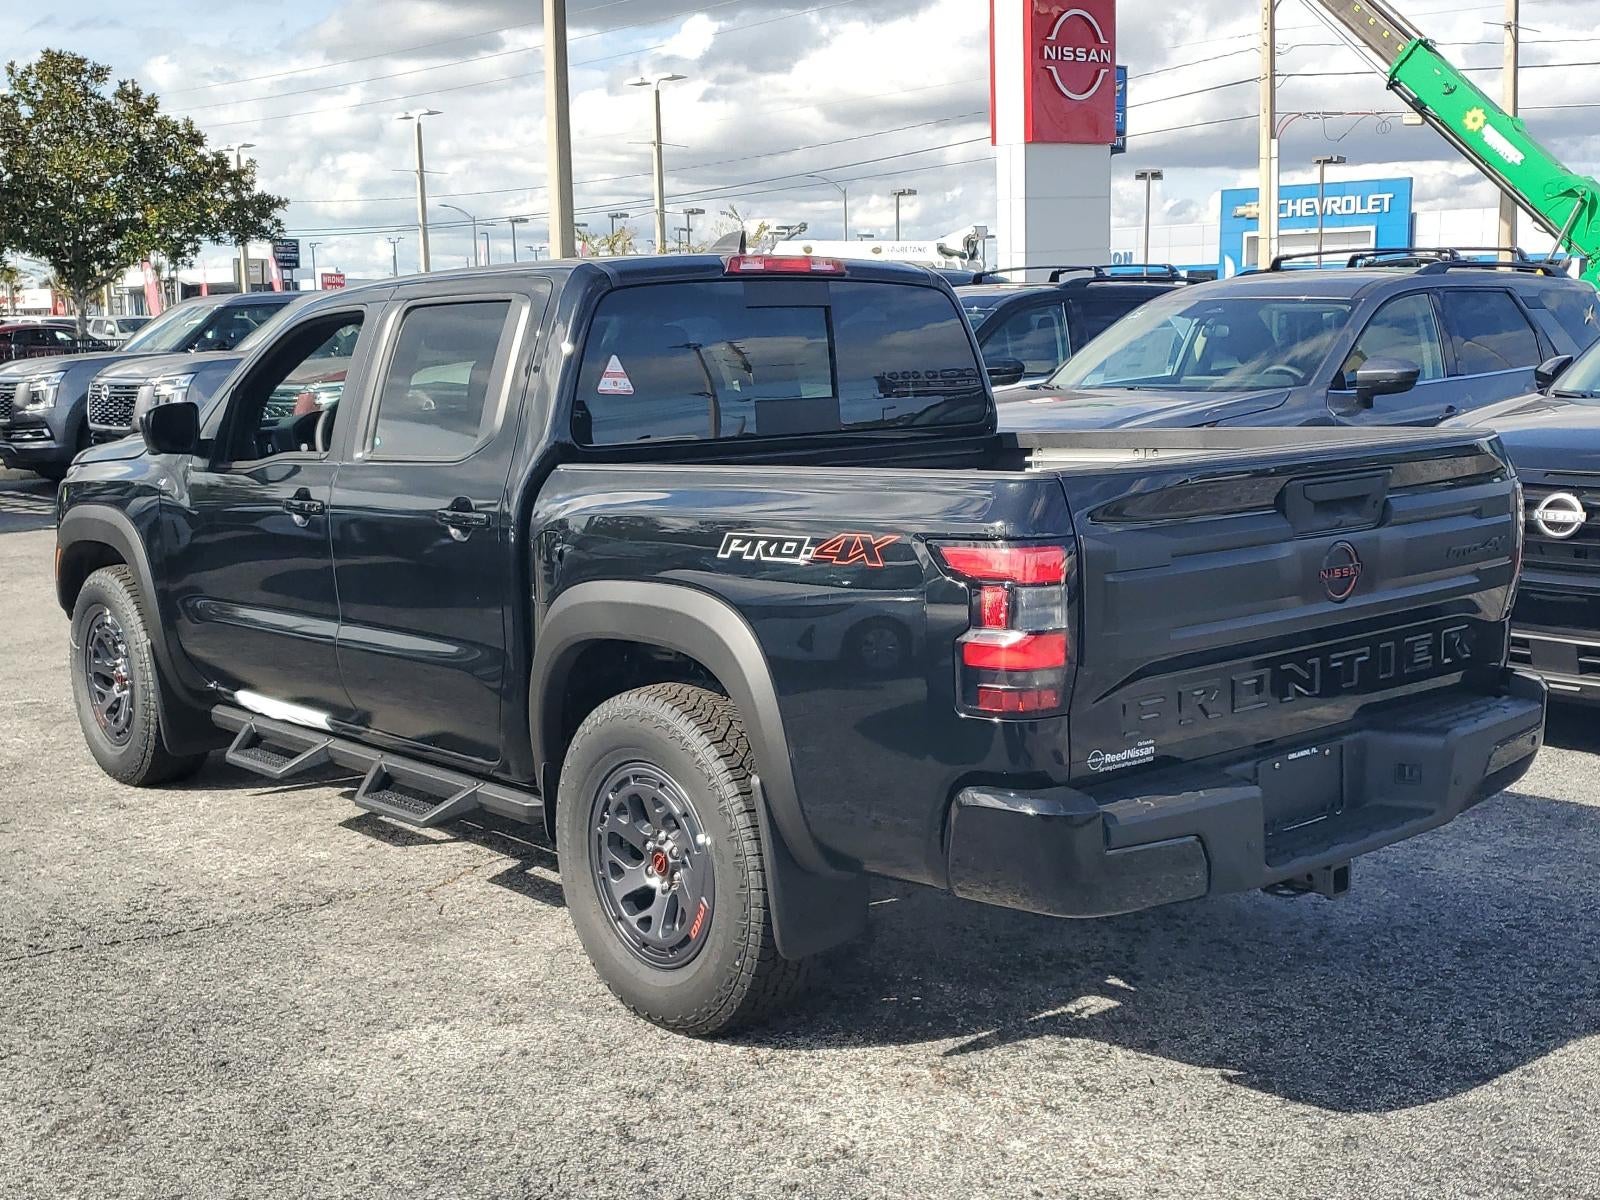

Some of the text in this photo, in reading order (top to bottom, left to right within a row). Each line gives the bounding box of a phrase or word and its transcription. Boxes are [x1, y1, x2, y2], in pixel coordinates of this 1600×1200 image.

[1043, 45, 1111, 63] NISSAN
[1278, 193, 1394, 218] CHEVROLET
[322, 275, 345, 284] WRONG
[1319, 562, 1362, 580] NISSAN
[1121, 623, 1472, 737] FRONTIER
[1105, 746, 1154, 763] Reed Nissan
